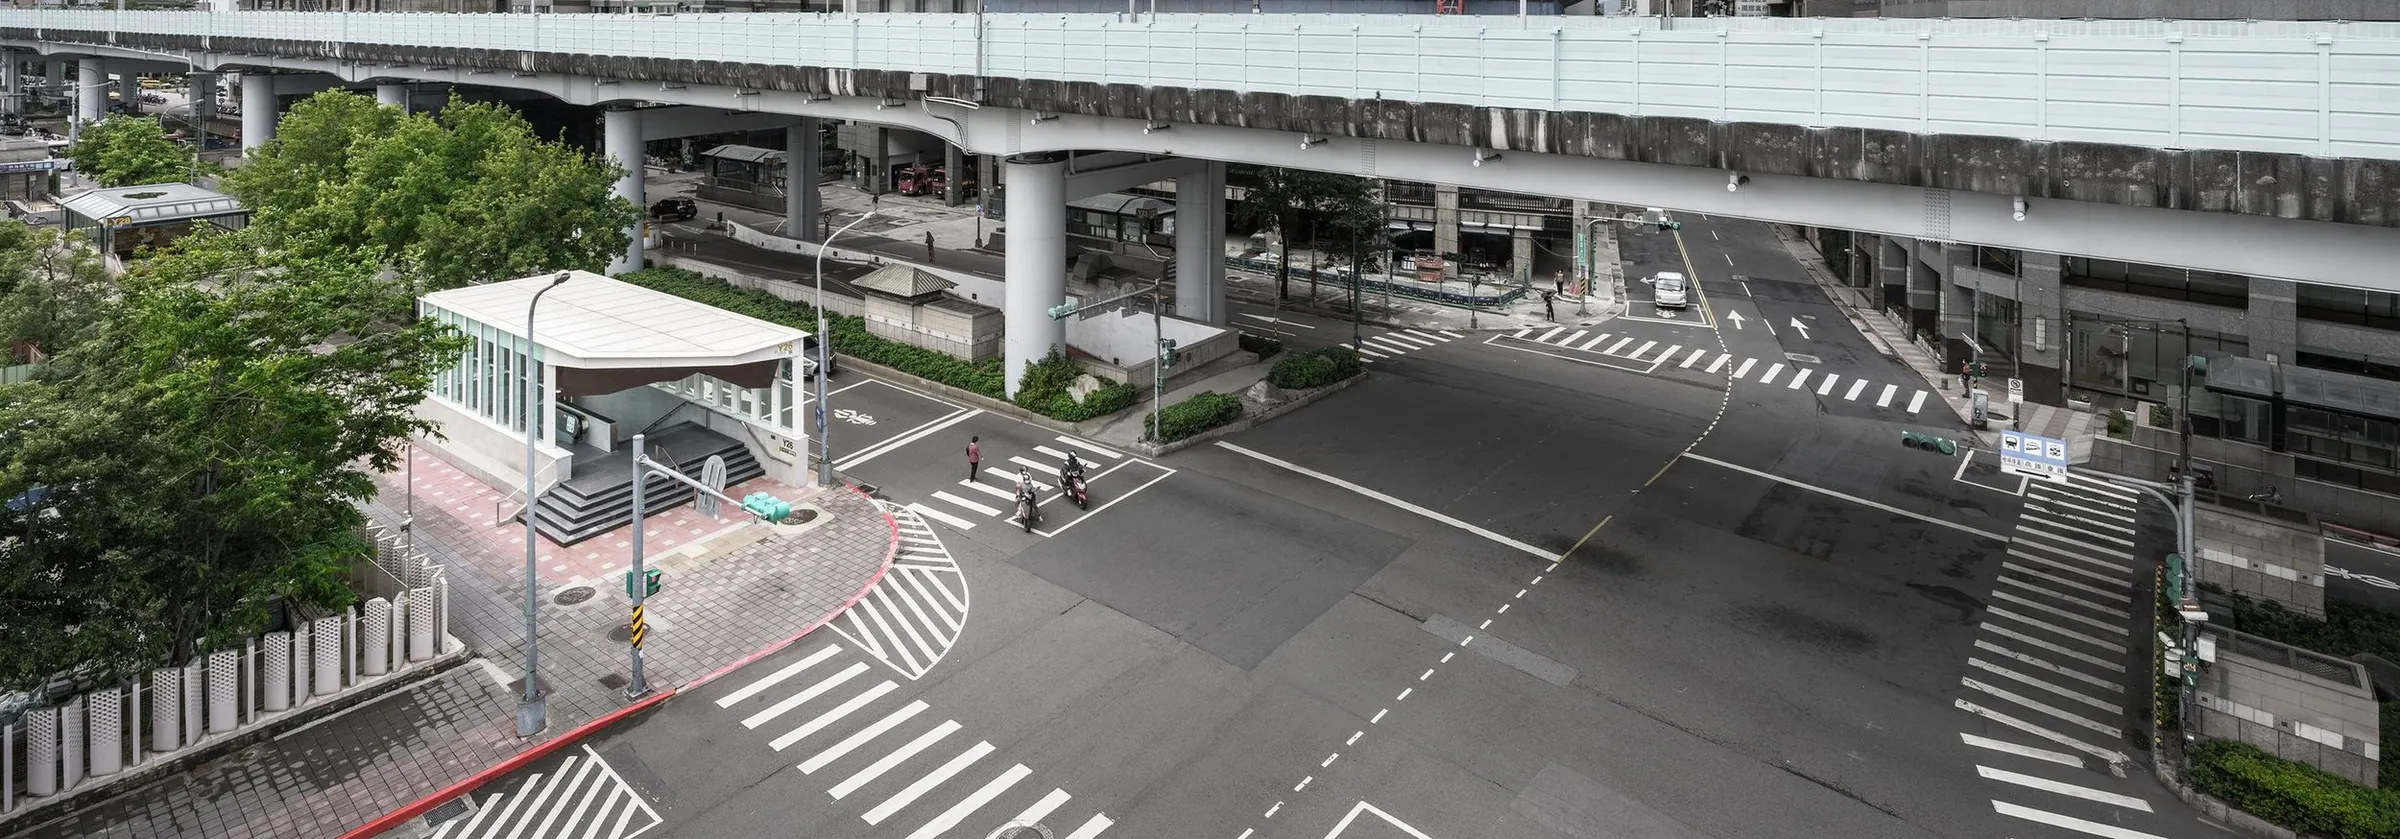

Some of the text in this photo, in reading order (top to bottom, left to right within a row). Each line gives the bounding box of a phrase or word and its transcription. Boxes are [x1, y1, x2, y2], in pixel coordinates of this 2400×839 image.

[111, 217, 131, 225] Y28
[778, 341, 793, 352] Y26
[783, 439, 794, 449] Y26
